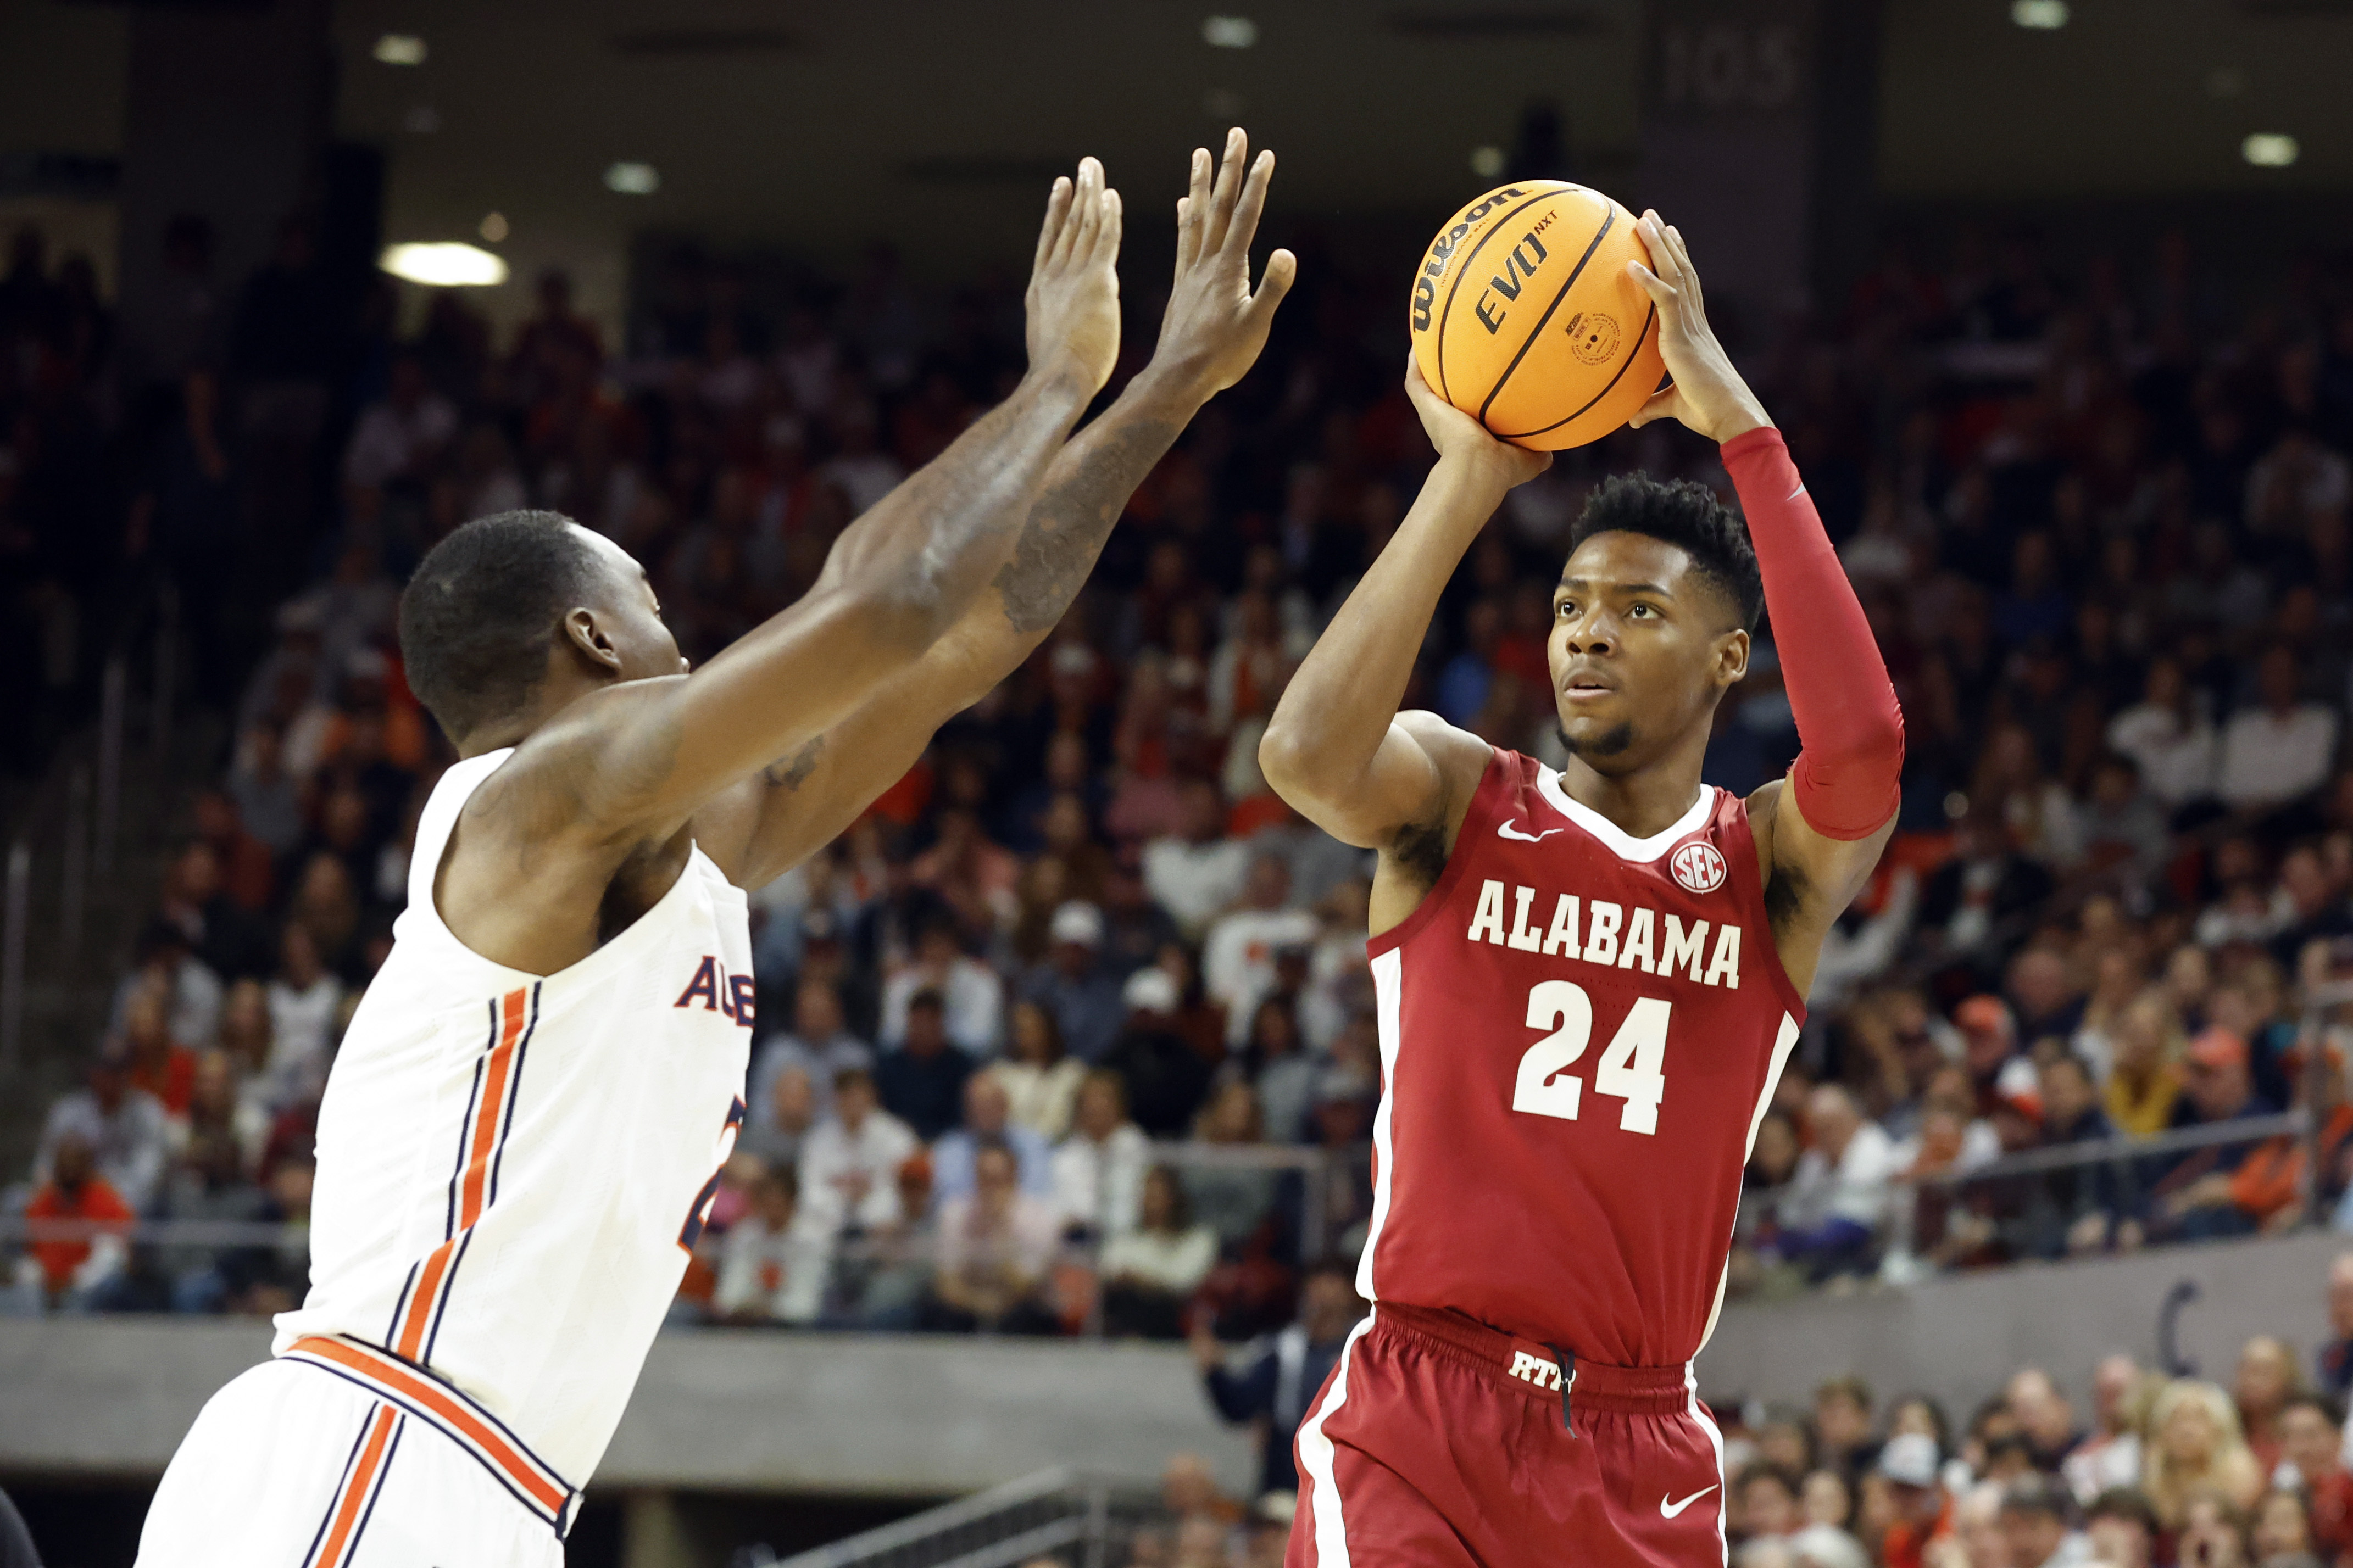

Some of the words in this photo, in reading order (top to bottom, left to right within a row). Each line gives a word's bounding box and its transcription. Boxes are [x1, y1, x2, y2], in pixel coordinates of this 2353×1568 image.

[1666, 29, 1795, 104] 105
[1413, 188, 1527, 333] Wilson
[1533, 209, 1558, 235] NXT
[1675, 846, 1722, 889] SEC
[1467, 879, 1742, 990] ALABAMA
[1512, 979, 1672, 1136] 24
